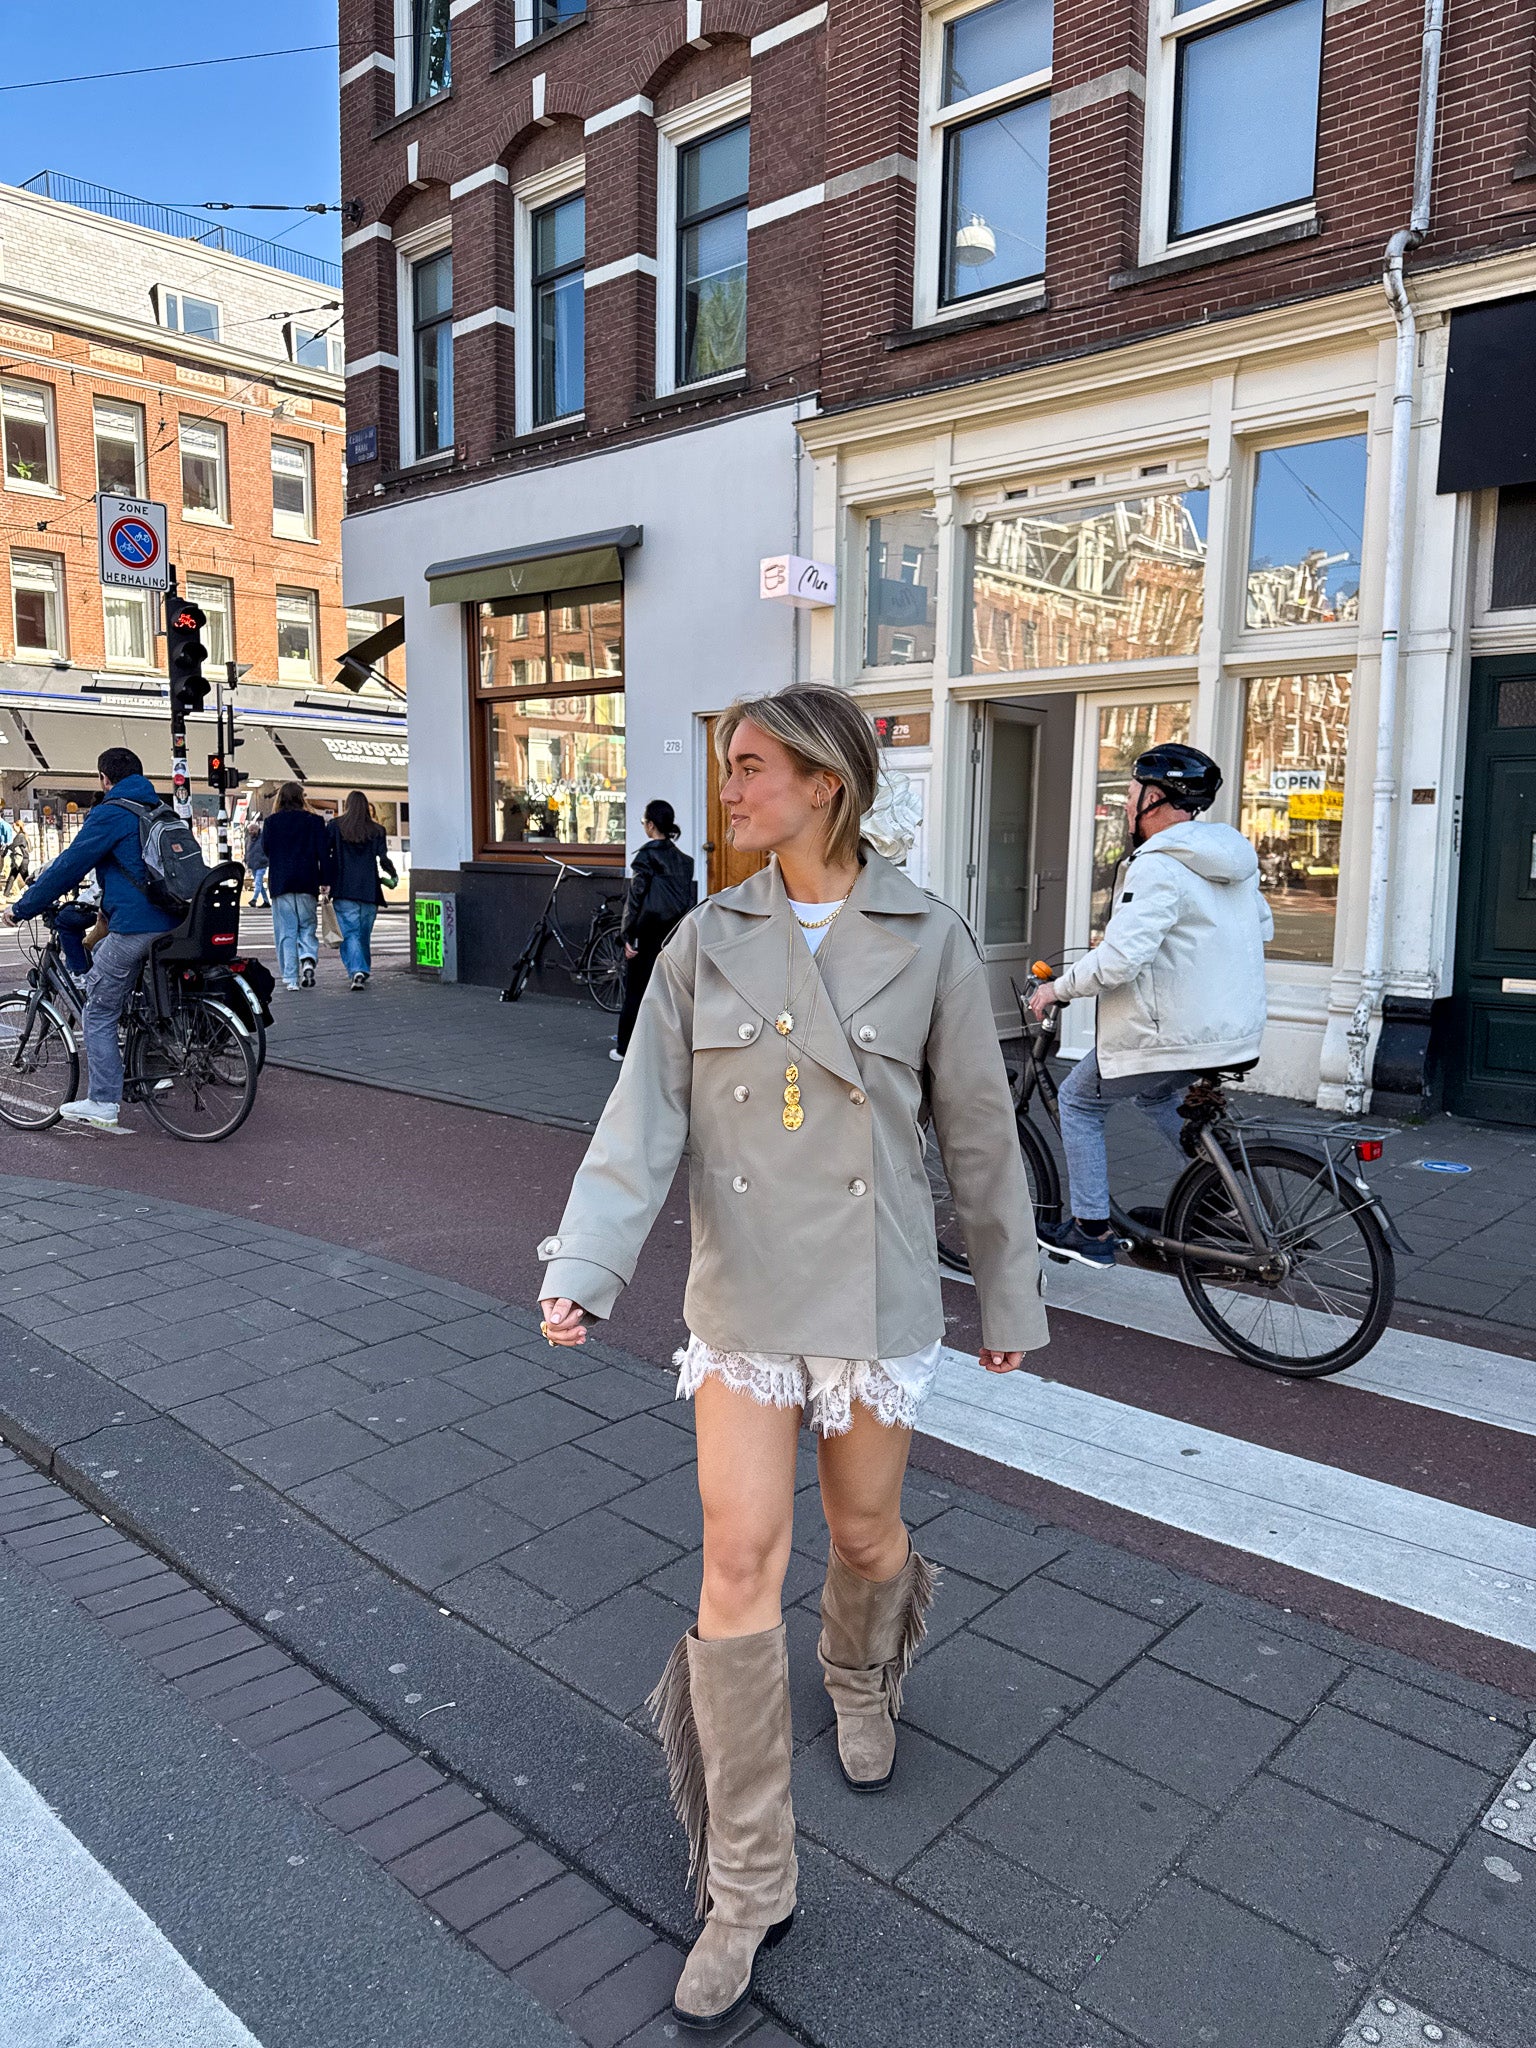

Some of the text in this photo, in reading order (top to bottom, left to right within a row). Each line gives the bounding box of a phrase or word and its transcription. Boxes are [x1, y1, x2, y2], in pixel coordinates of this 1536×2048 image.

[118, 502, 149, 515] ZONE
[106, 571, 165, 588] HERHALING
[893, 725, 909, 735] 276
[666, 741, 681, 752] 278
[1275, 775, 1320, 790] OPEN
[425, 941, 440, 960] TIE
